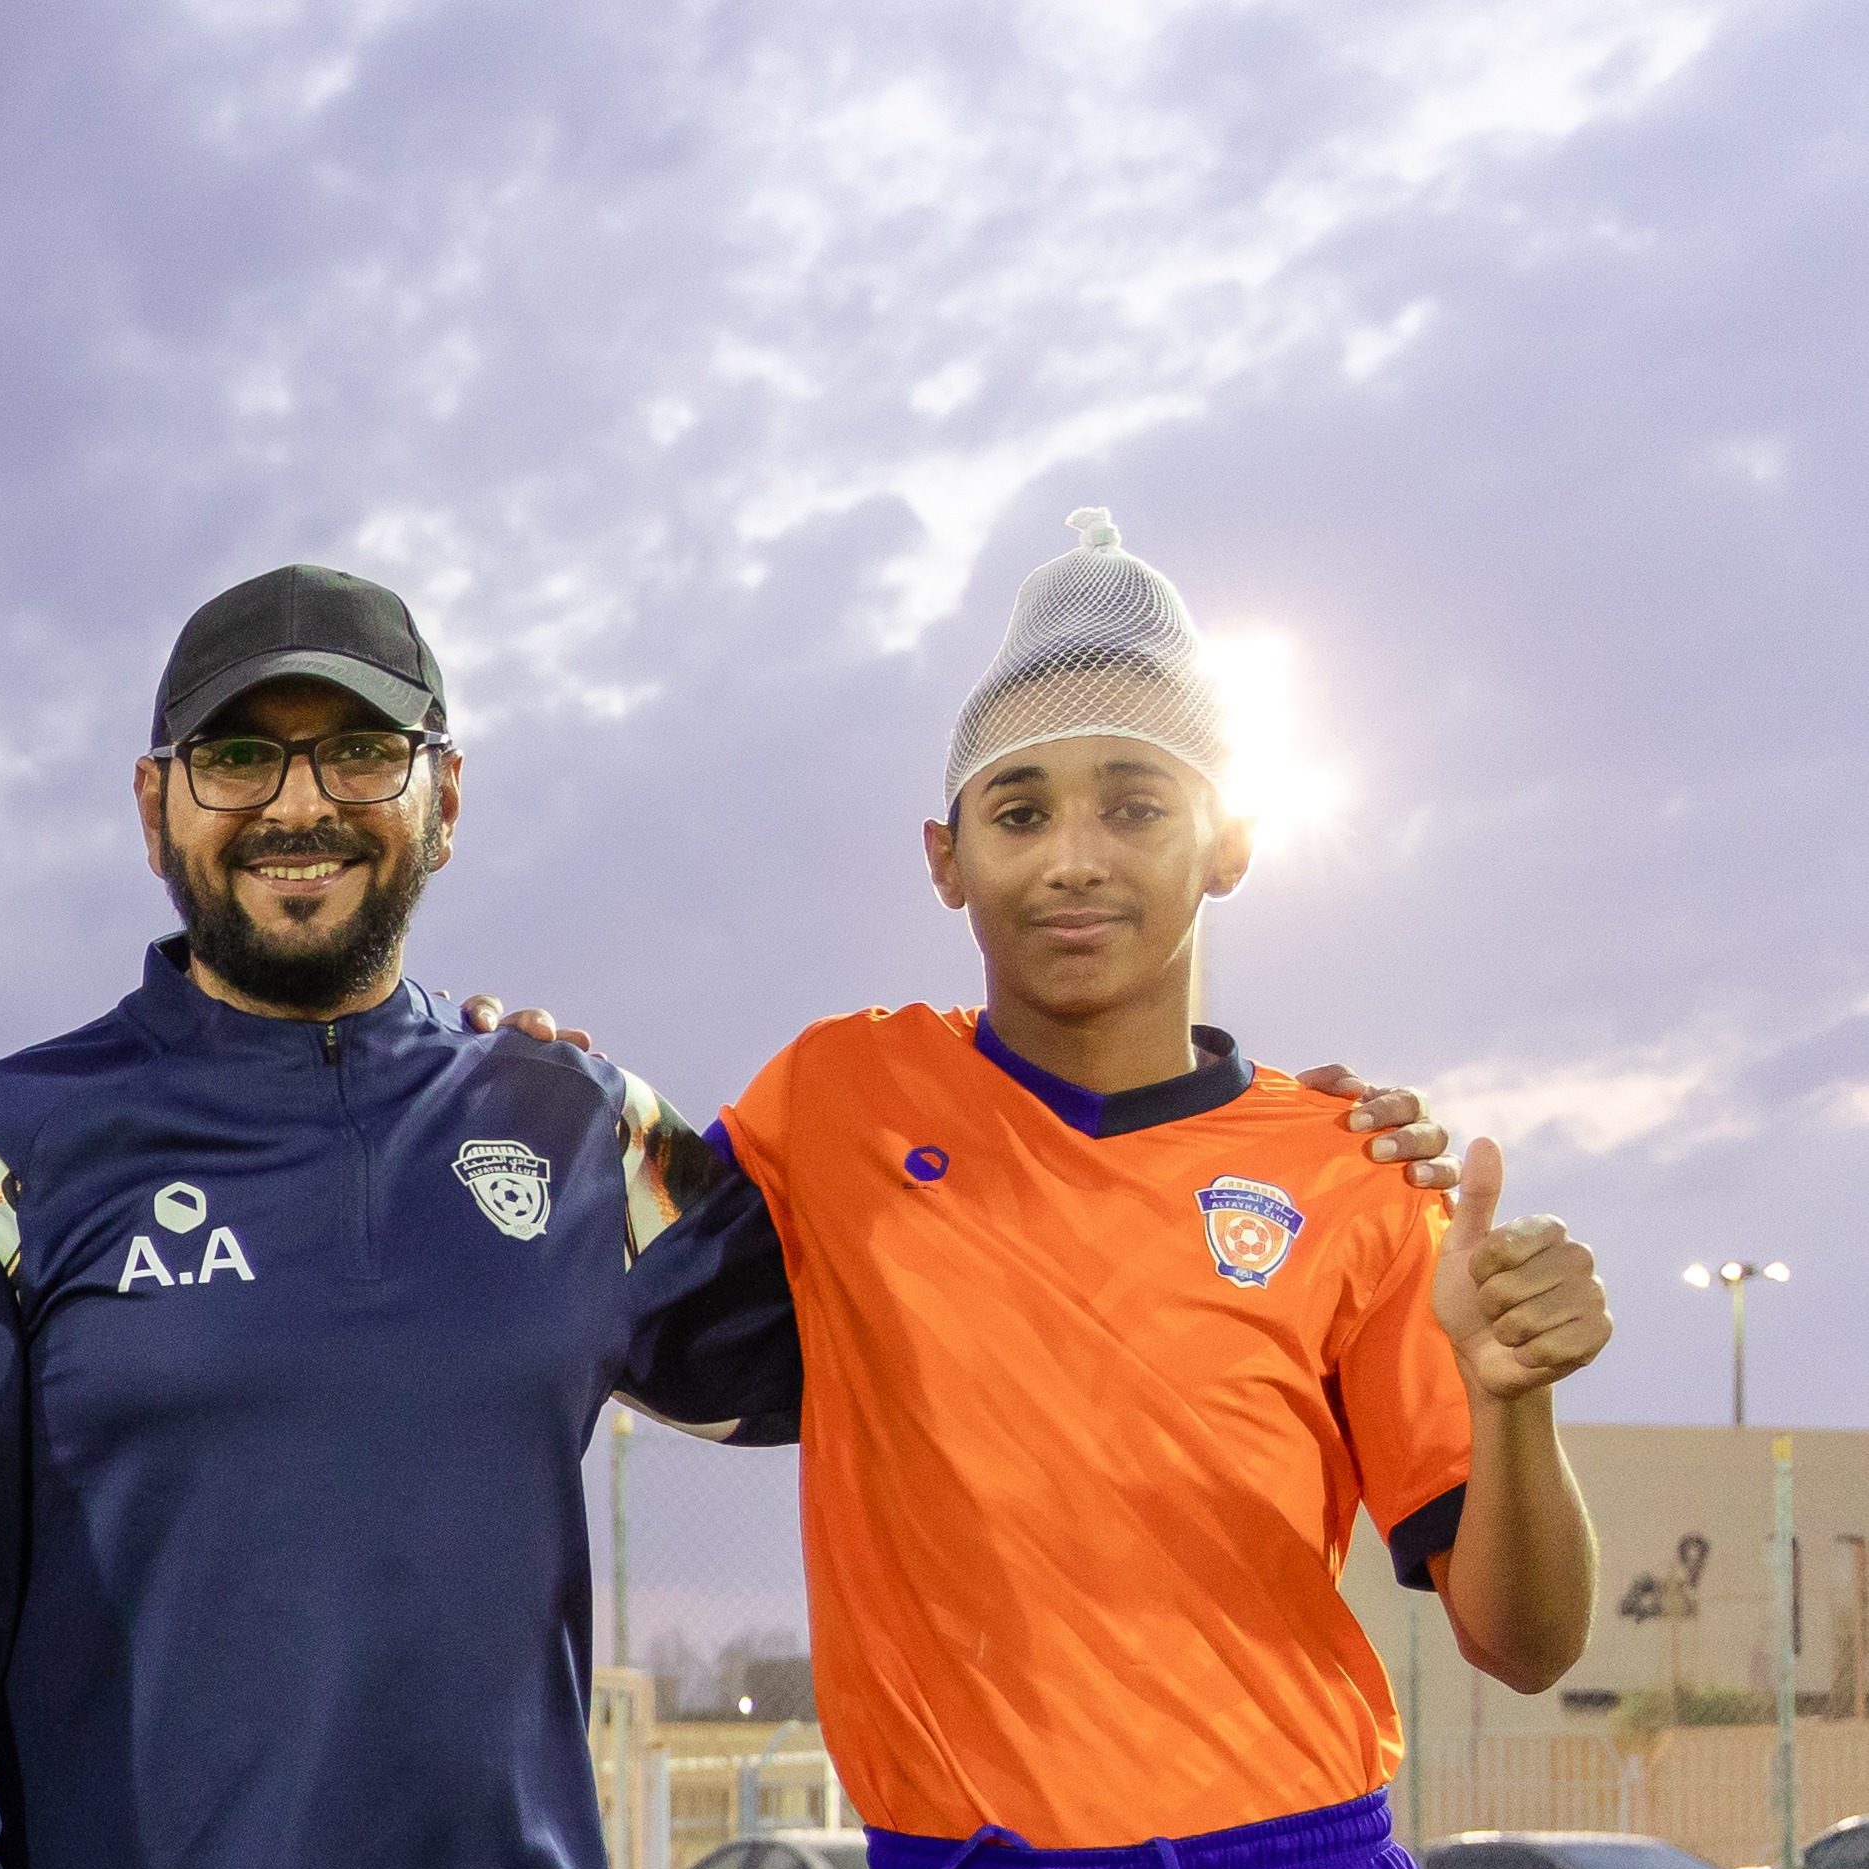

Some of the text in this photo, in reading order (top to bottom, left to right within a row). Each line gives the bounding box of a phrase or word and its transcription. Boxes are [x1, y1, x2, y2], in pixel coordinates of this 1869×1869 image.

[511, 1166, 538, 1177] CLUB
[1211, 1201, 1290, 1227] ALFAYHA CLUB
[118, 1226, 256, 1293] A.A
